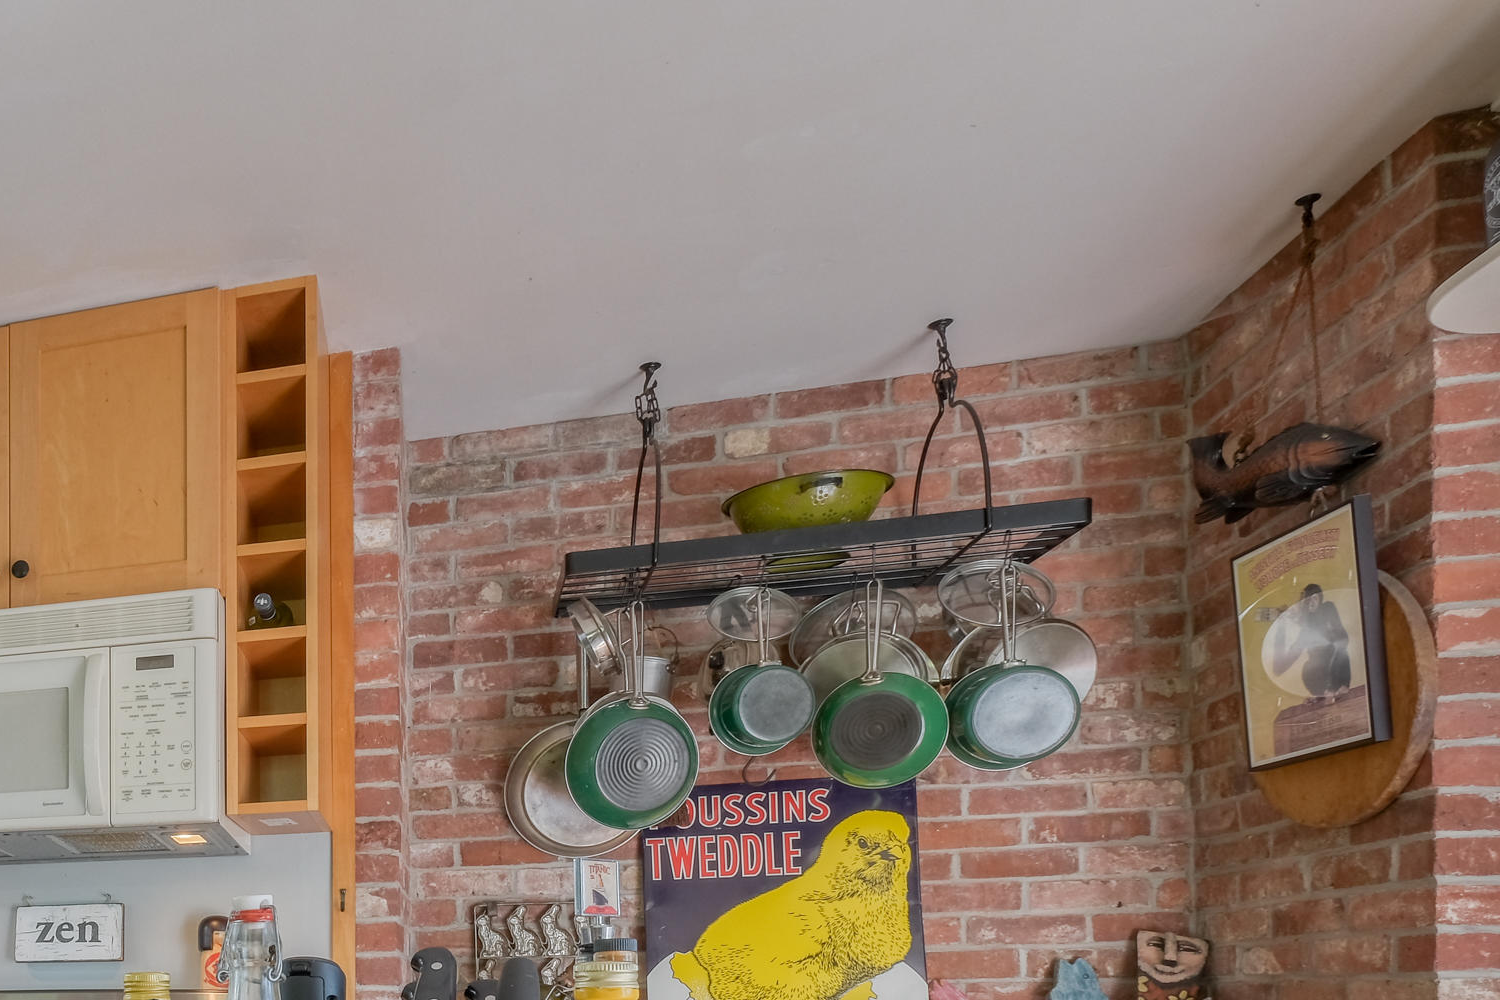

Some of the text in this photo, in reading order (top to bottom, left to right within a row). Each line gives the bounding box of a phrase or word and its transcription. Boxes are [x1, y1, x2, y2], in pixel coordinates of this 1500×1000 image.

[650, 788, 831, 830] OUSSINS
[645, 831, 803, 881] TWEDDLE
[34, 917, 101, 943] zen
